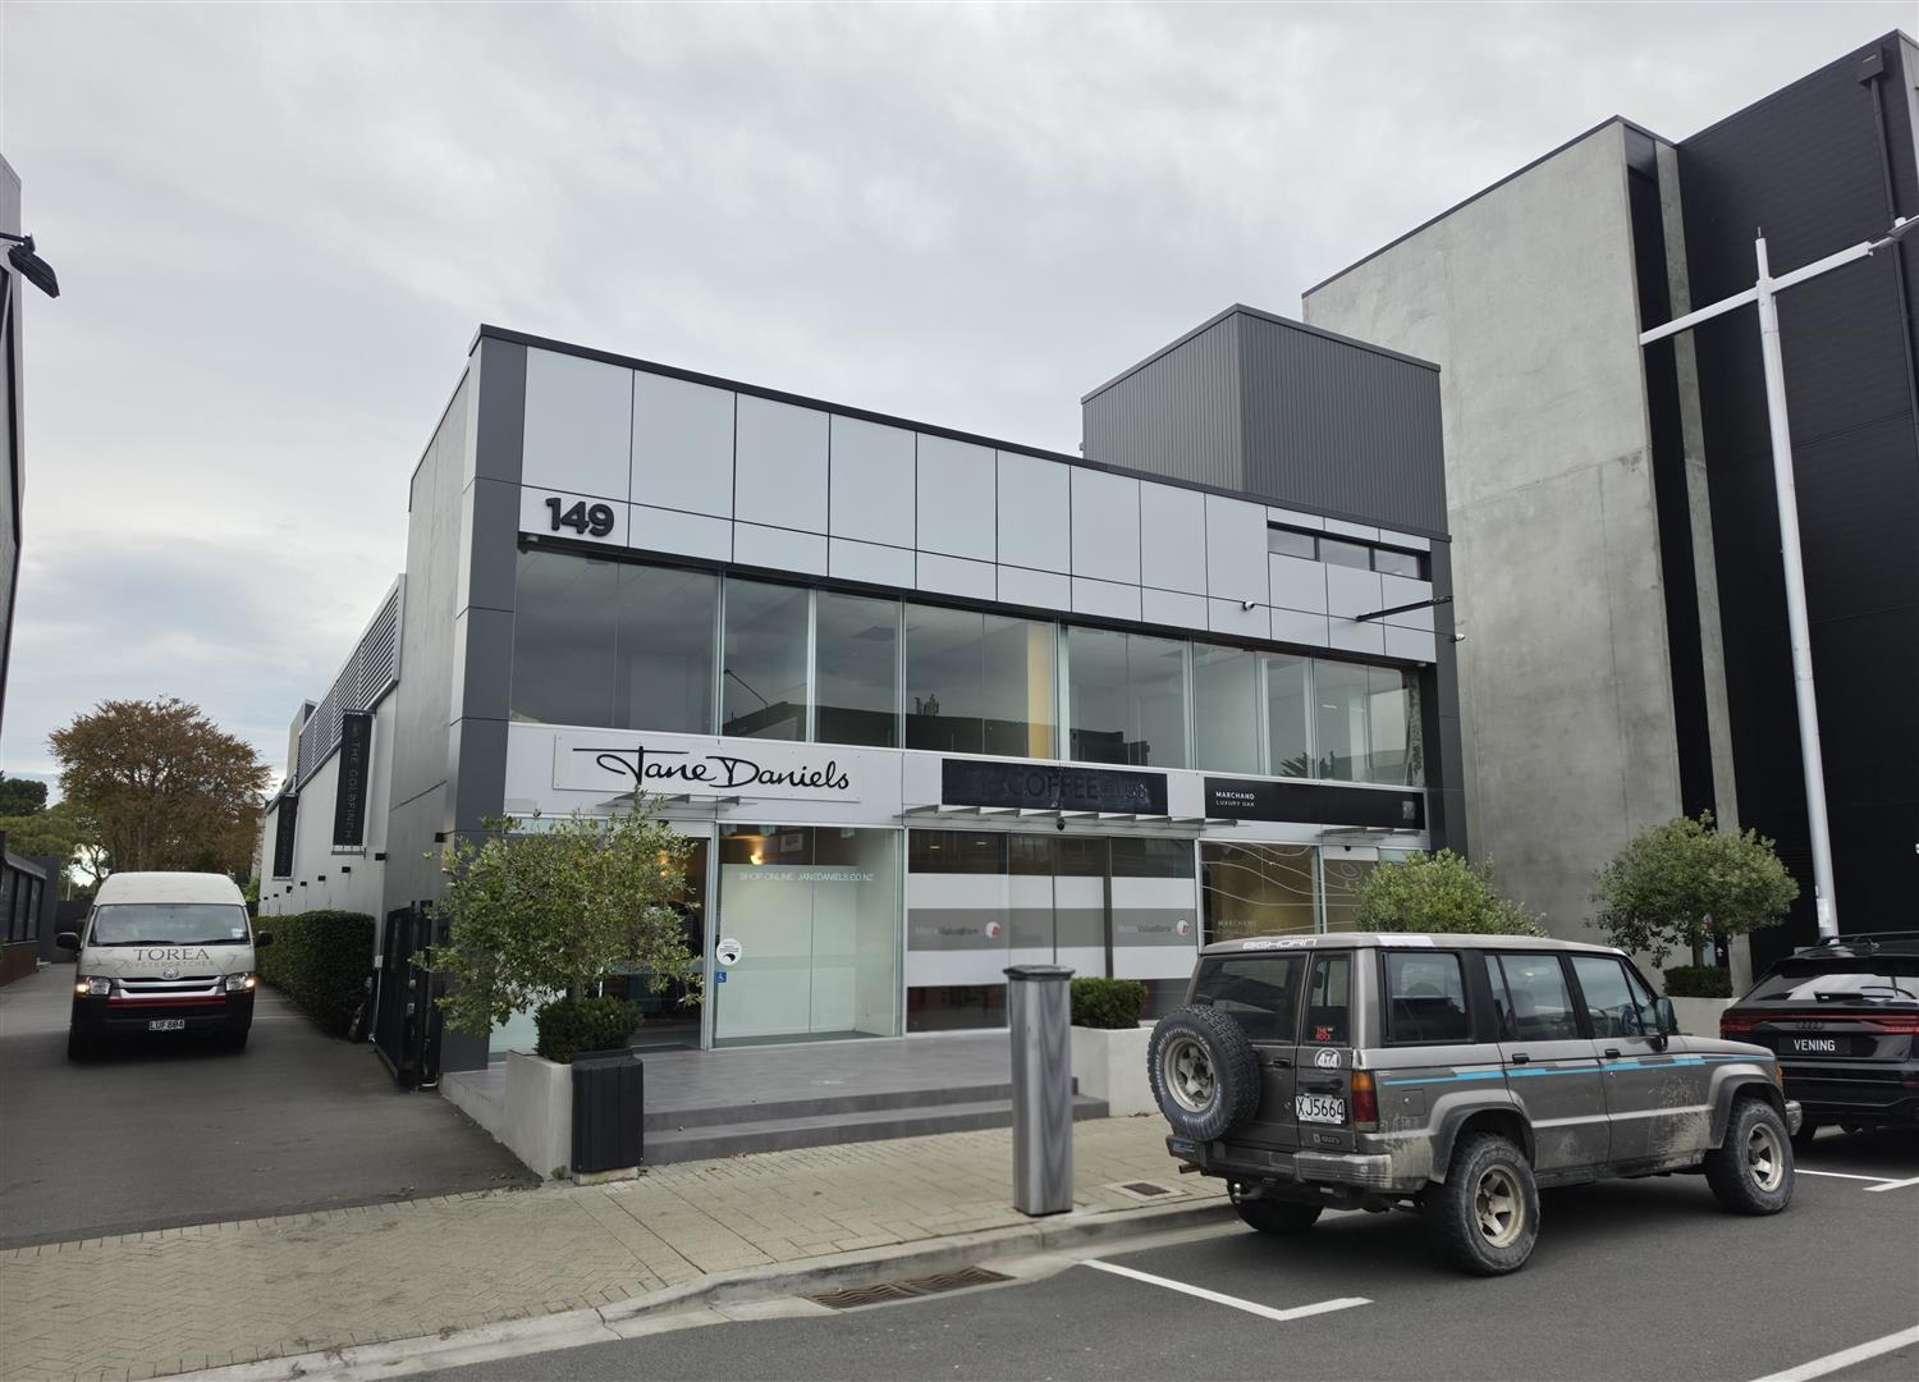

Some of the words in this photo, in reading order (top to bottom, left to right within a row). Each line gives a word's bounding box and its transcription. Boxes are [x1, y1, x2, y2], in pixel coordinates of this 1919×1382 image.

[545, 497, 614, 537] 149
[572, 746, 717, 787] Jane
[705, 755, 849, 790] Daniels
[1215, 791, 1256, 800] MARCHAND
[134, 947, 210, 961] TOREA
[1794, 1039, 1836, 1052] VENING
[1297, 1097, 1344, 1118] XJ5664
